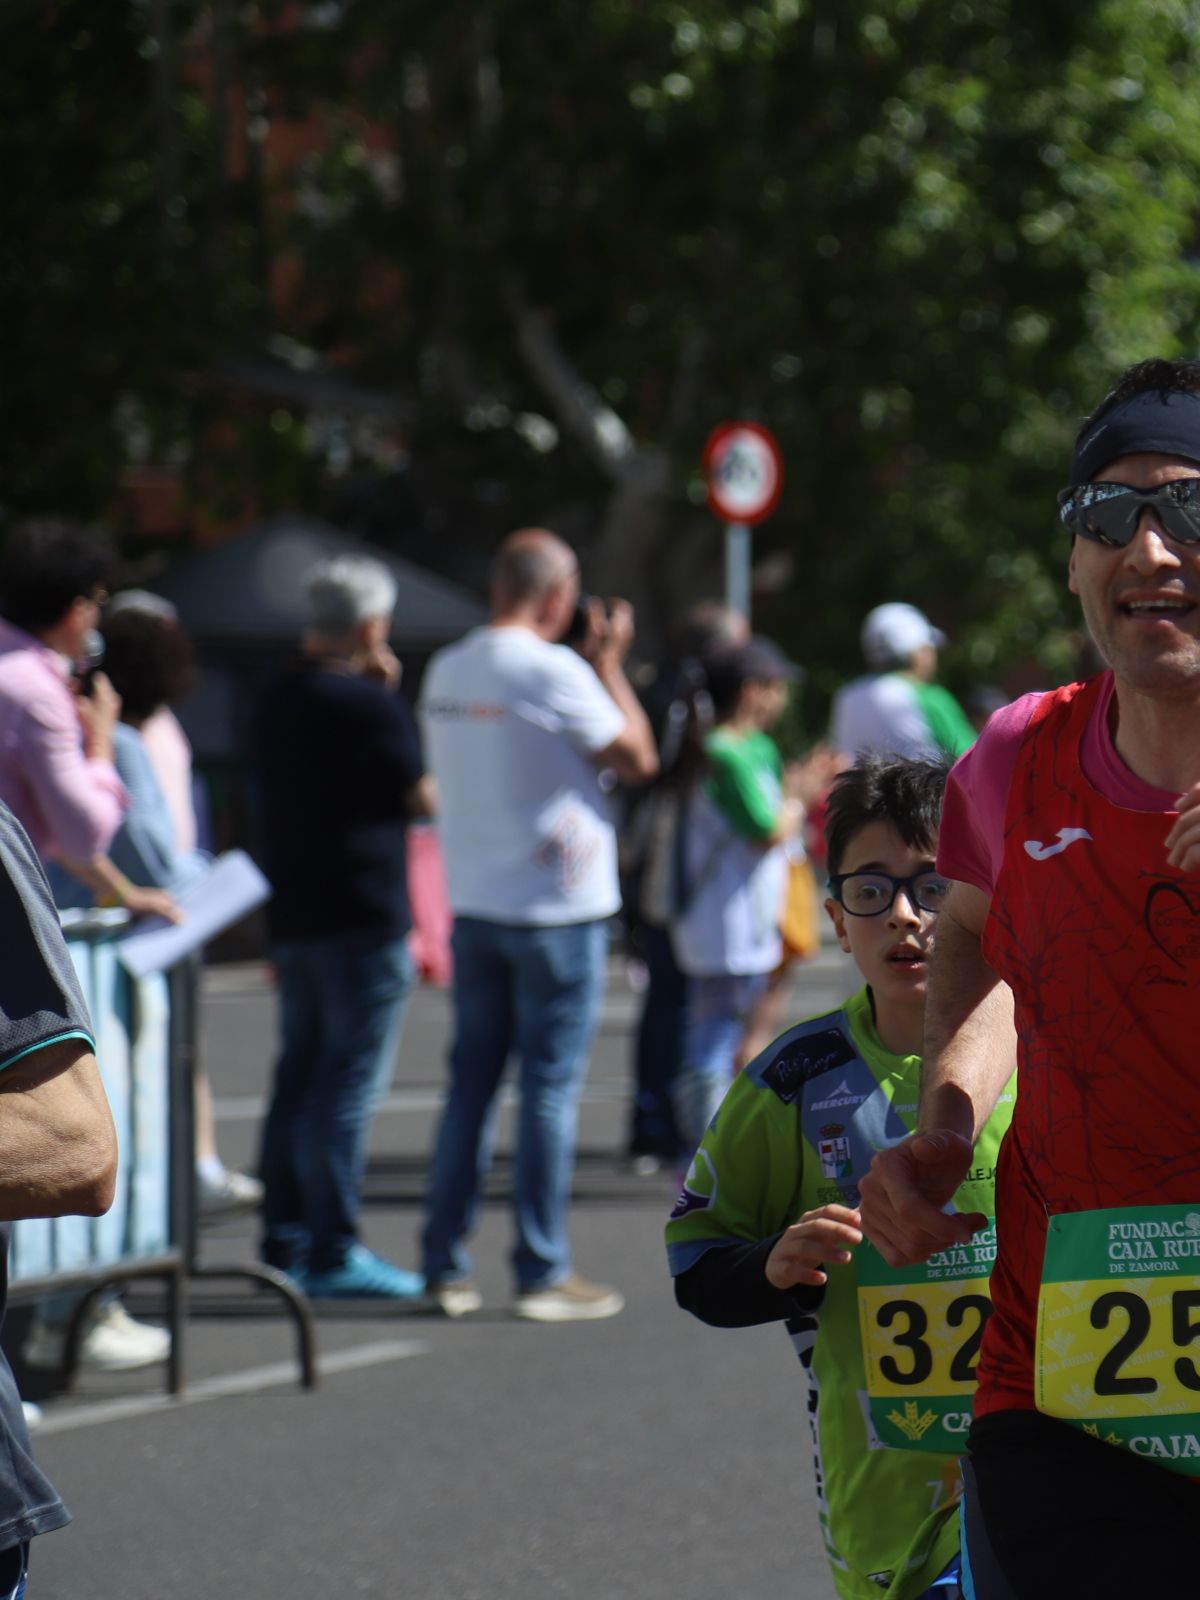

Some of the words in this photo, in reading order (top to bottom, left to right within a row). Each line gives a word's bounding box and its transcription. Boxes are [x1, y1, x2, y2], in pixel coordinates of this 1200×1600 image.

[810, 1095, 869, 1112] MERCURY
[1109, 1242, 1158, 1261] CAJA
[927, 1269, 942, 1278] DE
[944, 1264, 988, 1276] ZAMORA
[1109, 1263, 1126, 1273] DE
[1129, 1261, 1180, 1273] ZAMORA
